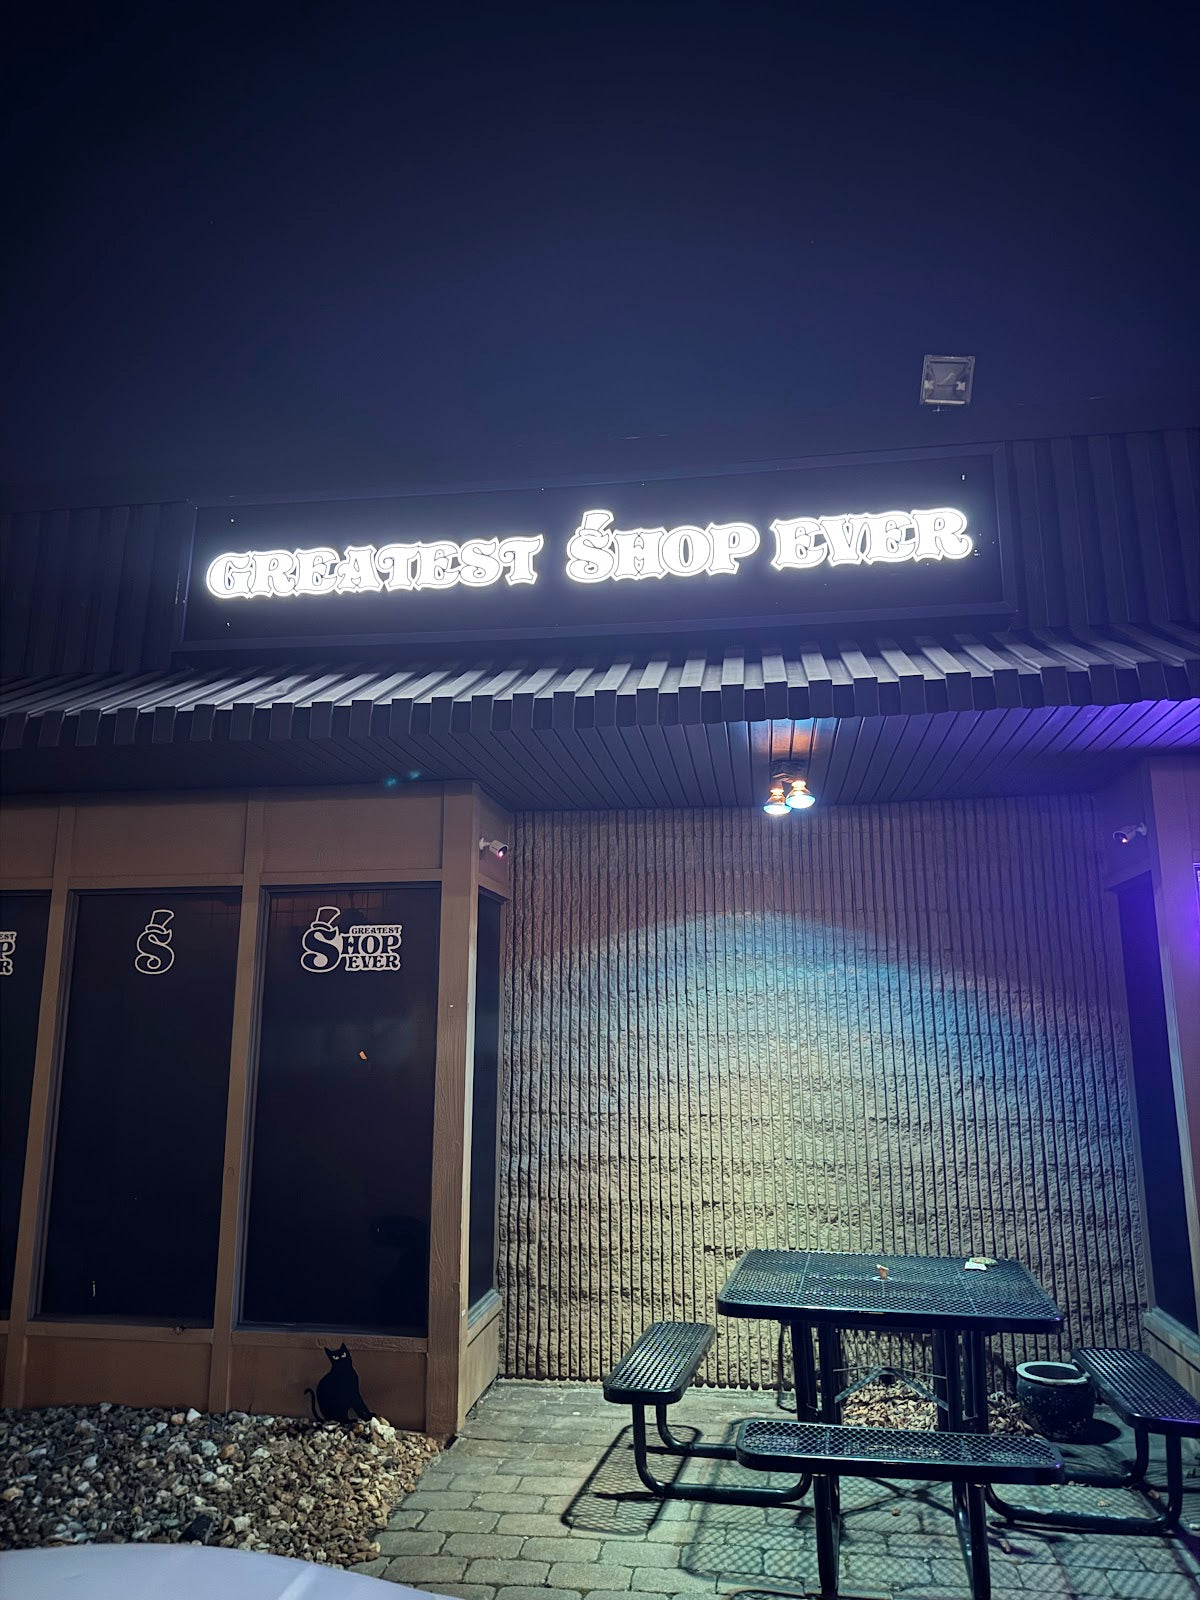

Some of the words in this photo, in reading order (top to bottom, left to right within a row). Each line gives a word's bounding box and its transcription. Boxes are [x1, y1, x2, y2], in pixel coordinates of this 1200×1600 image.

[206, 534, 545, 599] GREATEST
[566, 520, 760, 583] SHOP
[770, 507, 973, 571] EVER
[351, 926, 401, 935] GREATEST
[301, 926, 401, 973] SHOP
[347, 955, 399, 969] EVER
